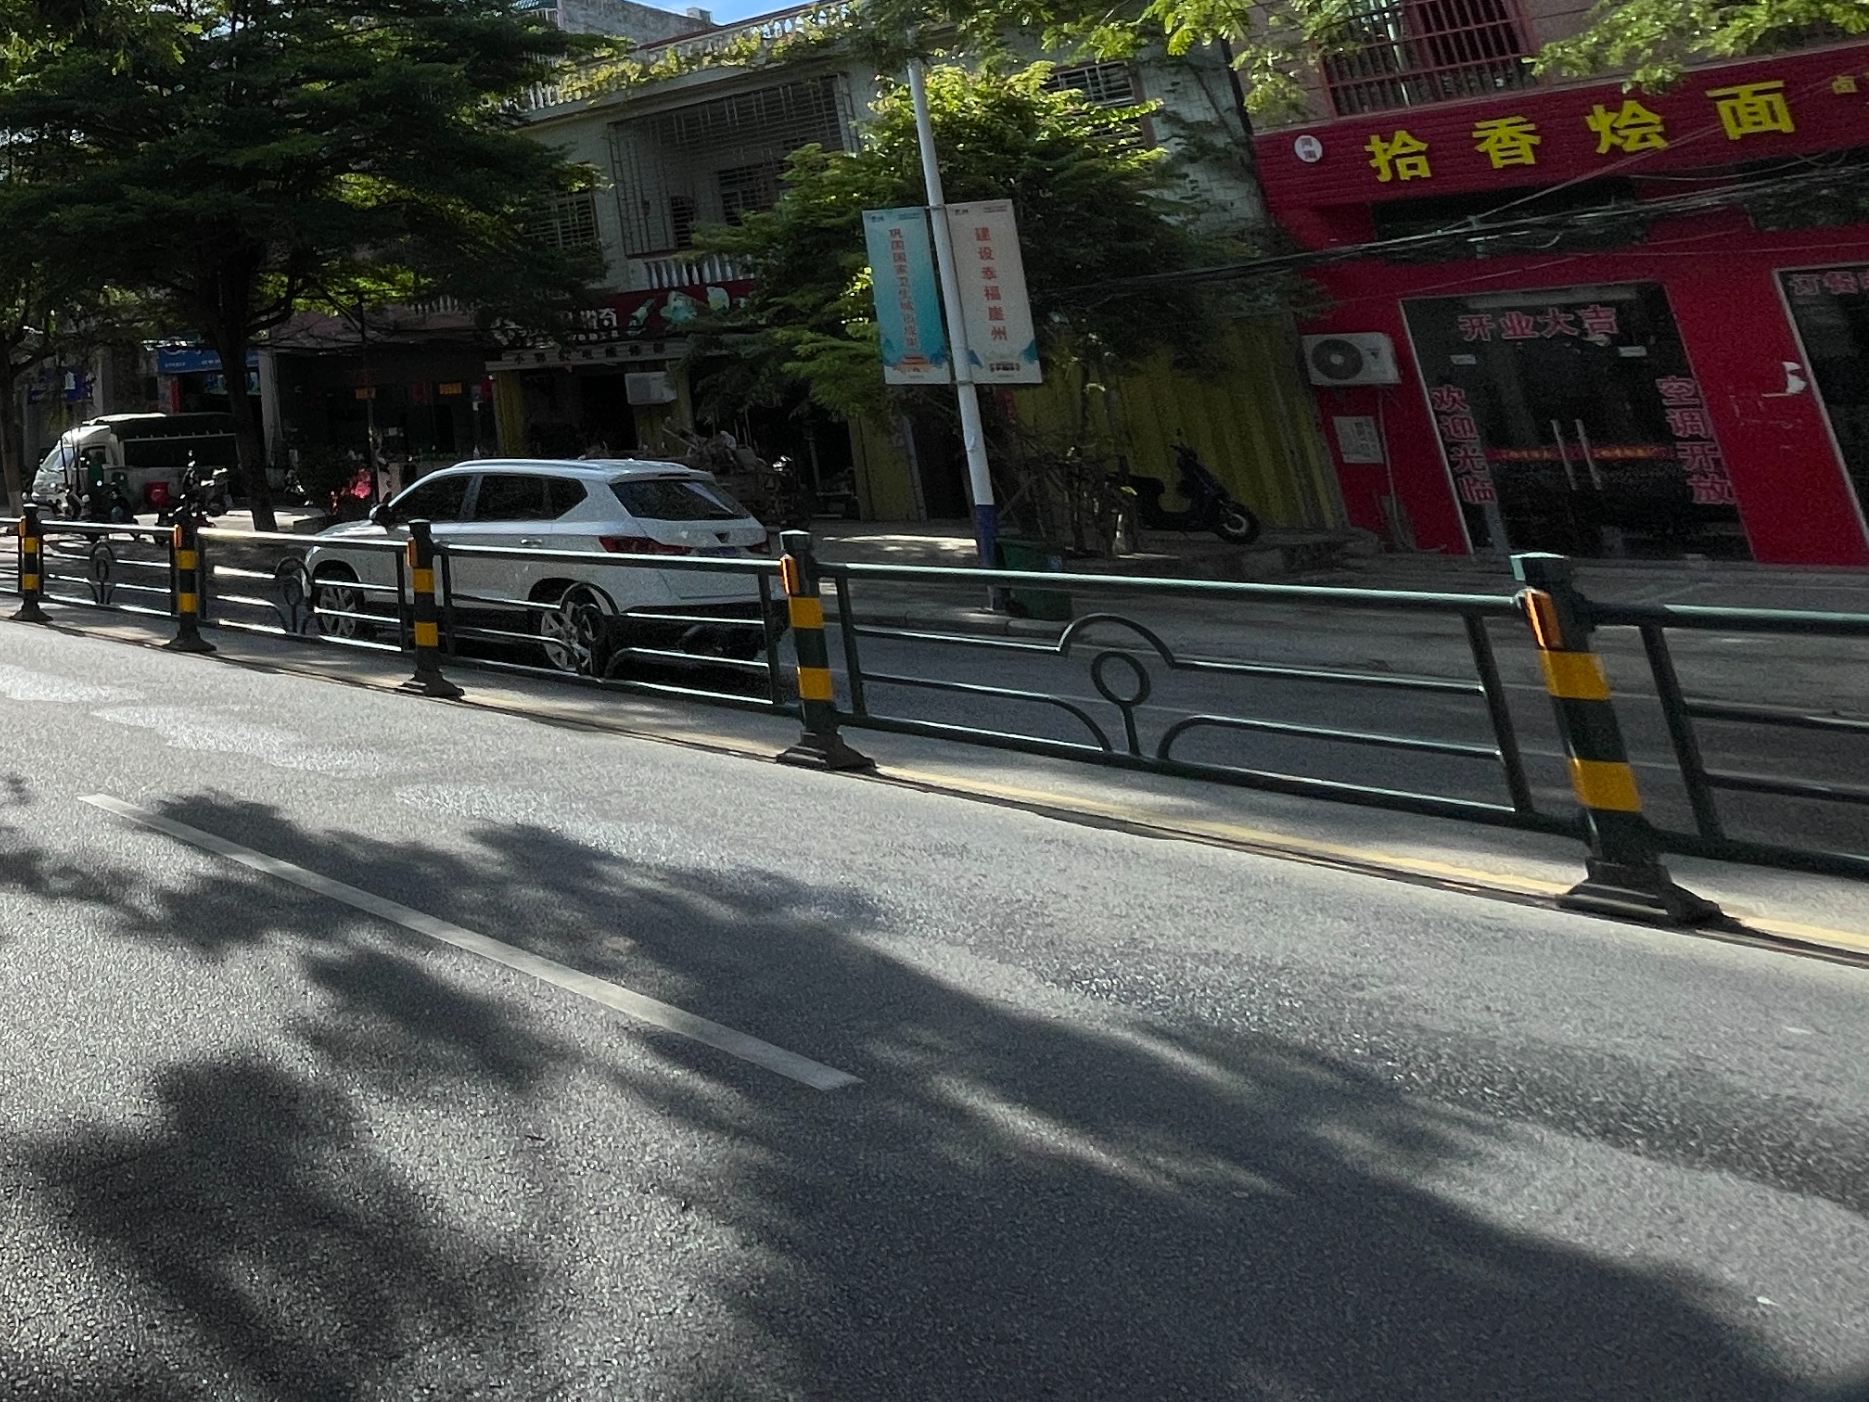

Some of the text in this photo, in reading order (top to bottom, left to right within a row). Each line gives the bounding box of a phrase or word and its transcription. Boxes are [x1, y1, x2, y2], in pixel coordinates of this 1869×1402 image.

[1363, 80, 1796, 183] 拾香烩面
[974, 226, 1008, 341] 建设幸福崖州
[1457, 304, 1619, 342] 开业大吉
[1431, 384, 1498, 505] 欢迎光临
[1655, 375, 1737, 505] 空调开放
